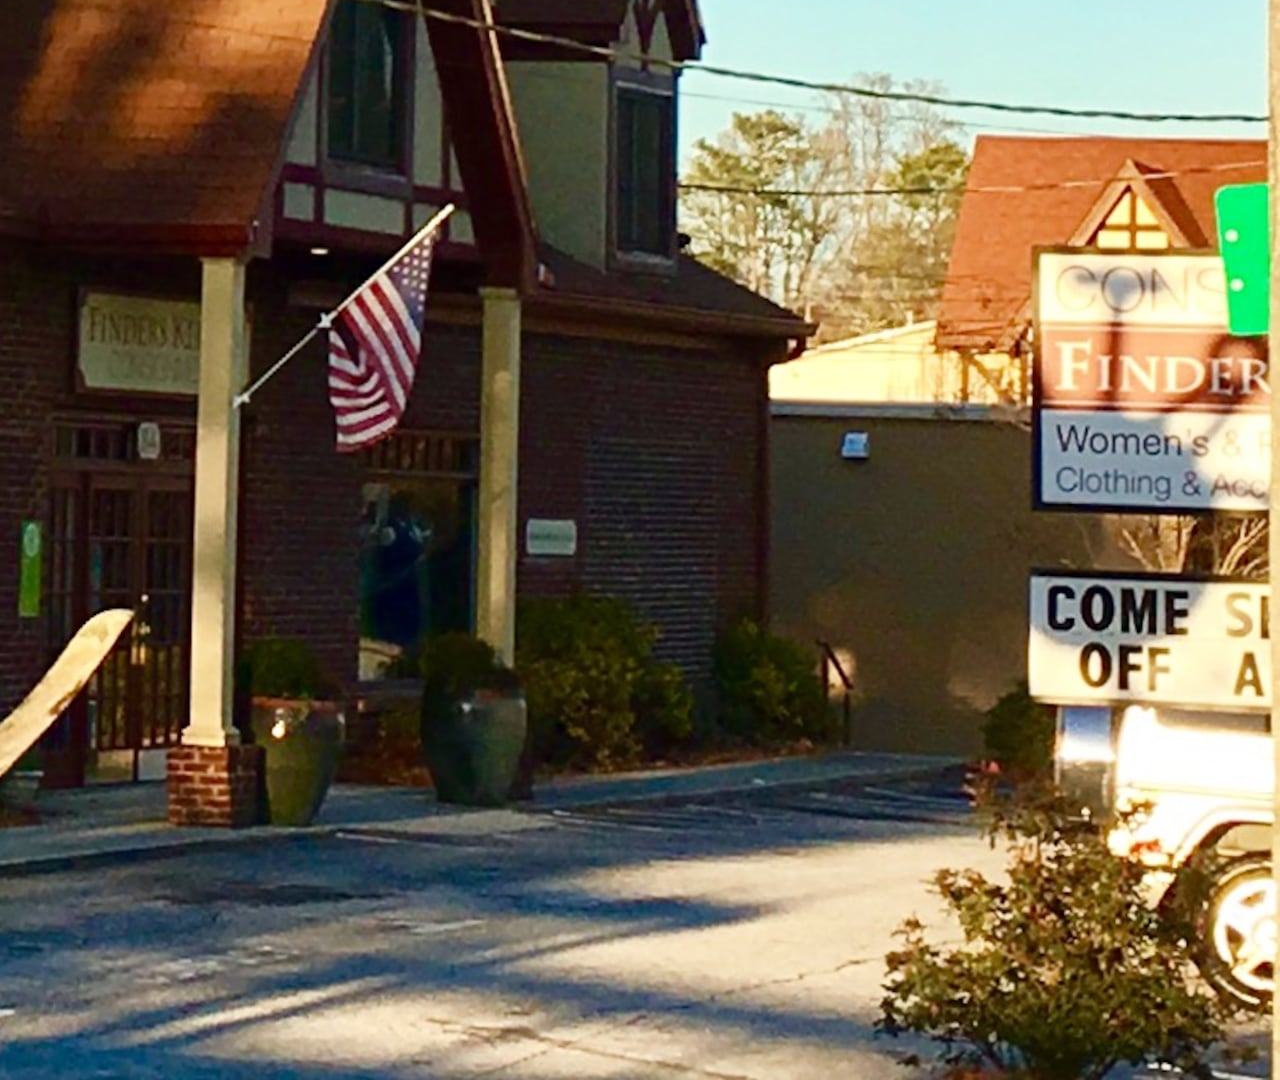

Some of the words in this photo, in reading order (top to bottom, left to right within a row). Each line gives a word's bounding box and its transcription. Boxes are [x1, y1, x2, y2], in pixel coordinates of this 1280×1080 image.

[1056, 265, 1228, 314] CONS
[1055, 339, 1271, 395] FINDER
[1056, 424, 1209, 456] Women's
[1223, 430, 1241, 456] &
[1056, 467, 1171, 501] Clothing
[1182, 471, 1201, 496] &
[1048, 585, 1188, 635] COME
[1080, 642, 1170, 691] OFF
[1234, 652, 1263, 696] A
